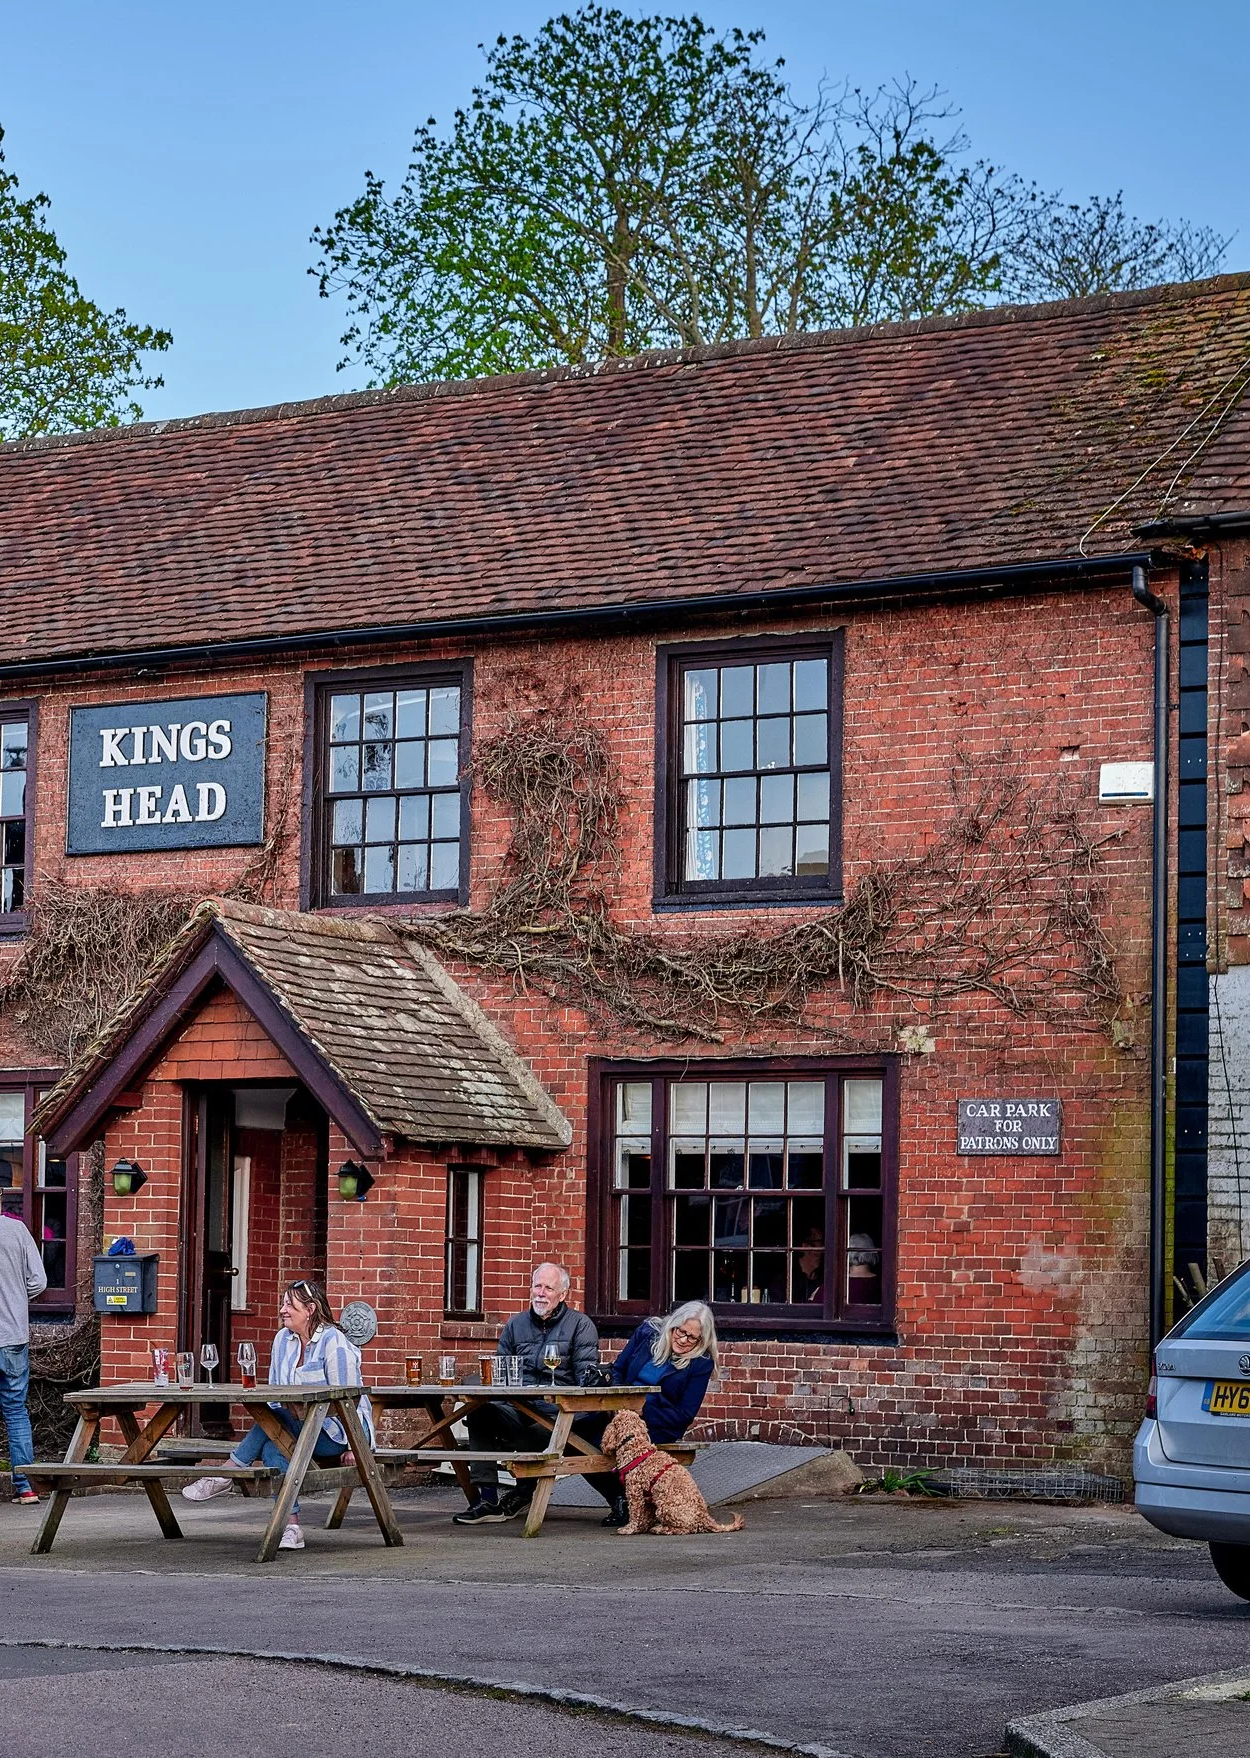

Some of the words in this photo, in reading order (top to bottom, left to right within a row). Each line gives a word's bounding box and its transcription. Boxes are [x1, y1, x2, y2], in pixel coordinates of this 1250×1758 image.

[99, 720, 232, 768] KINGS
[101, 782, 227, 828] HEAD
[966, 1104, 1001, 1117] CAR
[1005, 1103, 1051, 1117] PARK
[994, 1120, 1022, 1132] FOR
[960, 1136, 1019, 1150] PATRONS
[1022, 1136, 1058, 1150] ONLY
[1213, 1385, 1250, 1409] HY6
